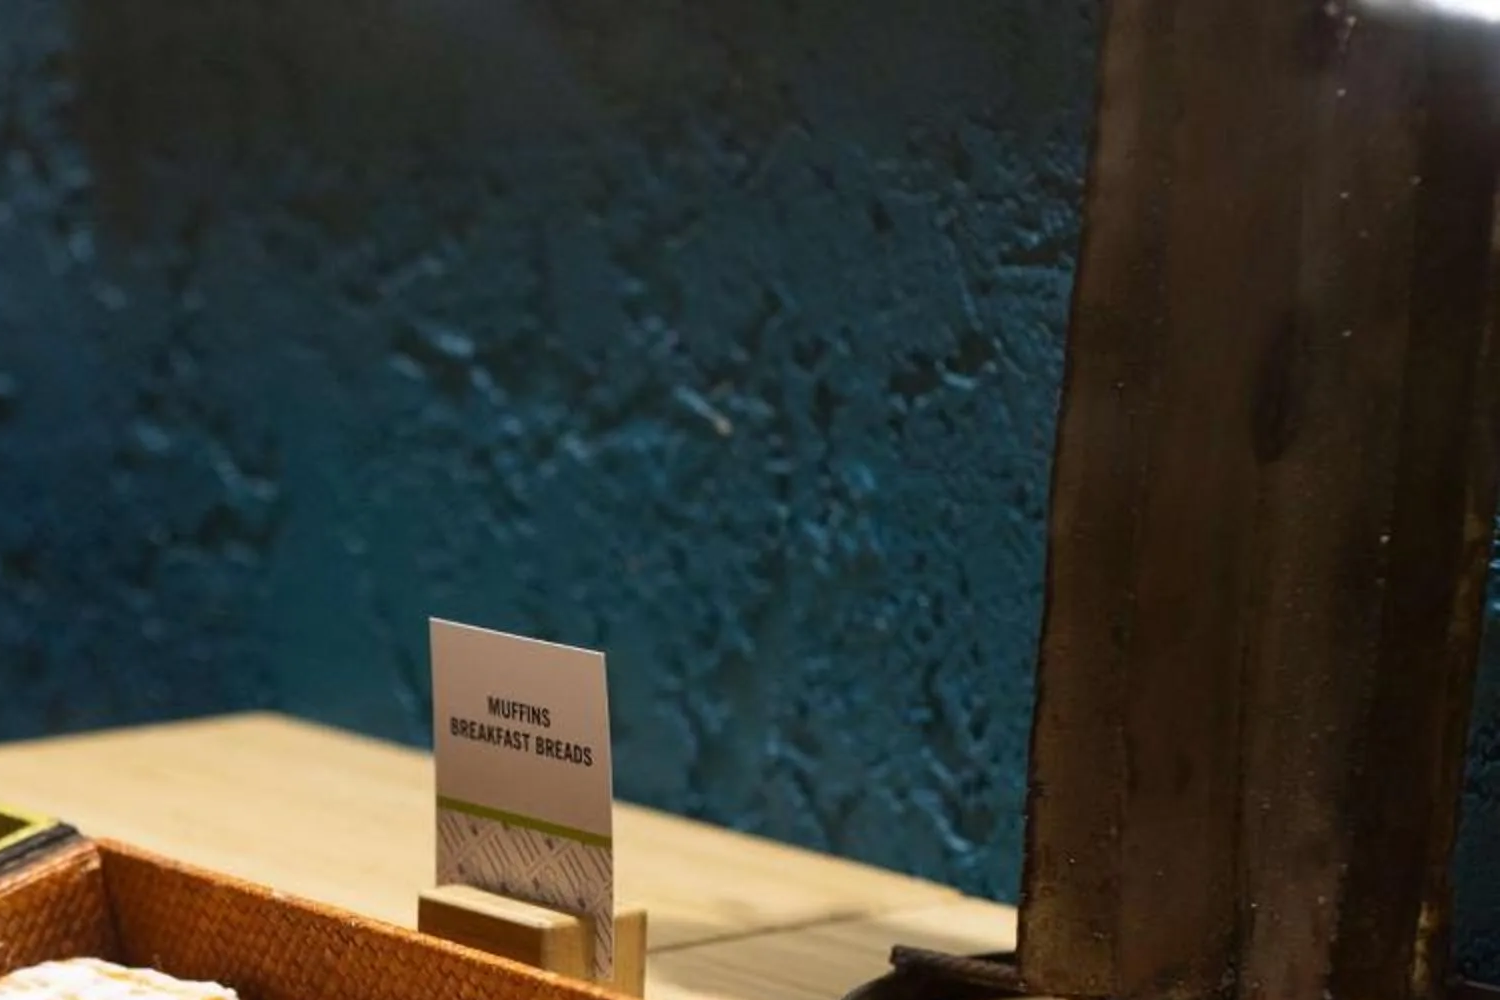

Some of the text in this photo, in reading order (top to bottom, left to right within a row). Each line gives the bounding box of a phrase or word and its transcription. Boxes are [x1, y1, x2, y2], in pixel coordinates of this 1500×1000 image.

[487, 695, 551, 728] MUFFINS
[450, 717, 593, 766] BREAKFAST BREADS
